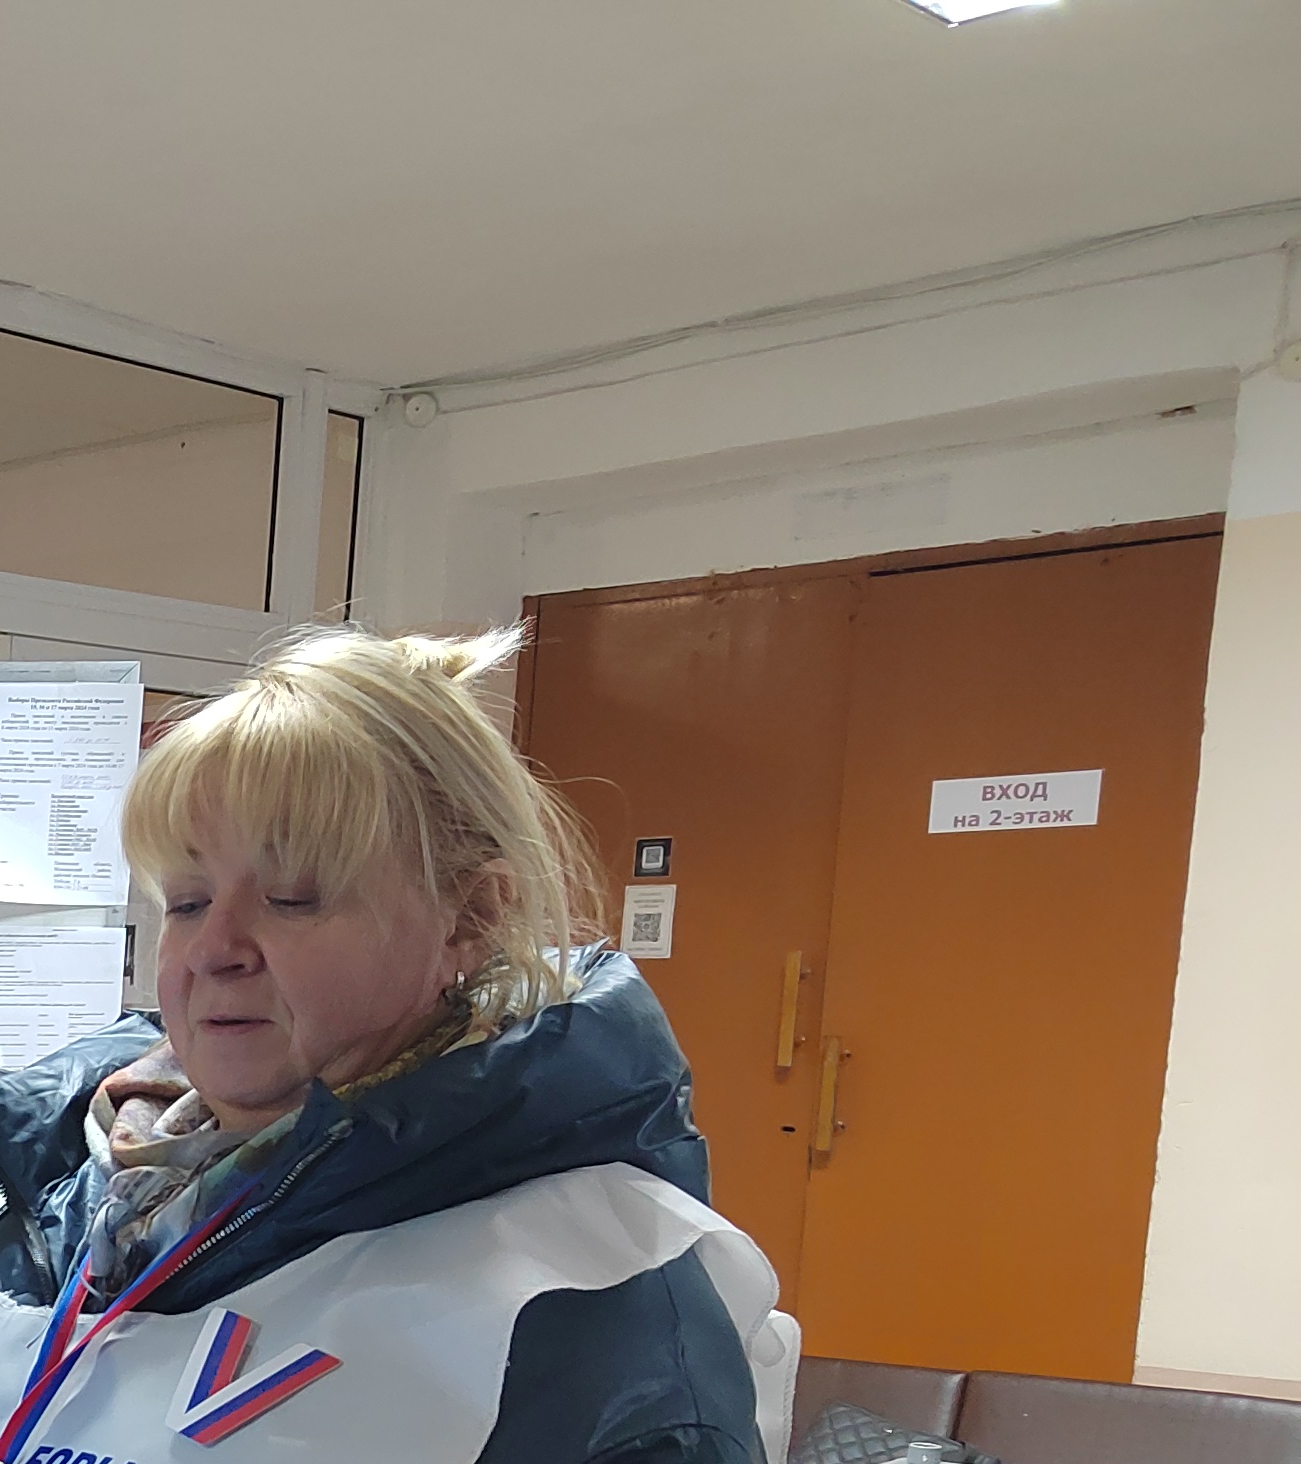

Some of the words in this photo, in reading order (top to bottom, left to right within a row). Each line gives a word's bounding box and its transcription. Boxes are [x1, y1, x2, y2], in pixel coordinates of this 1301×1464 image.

[981, 781, 1048, 802] ВХОД
[953, 814, 981, 829] на
[988, 809, 1074, 826] 2-этаж
